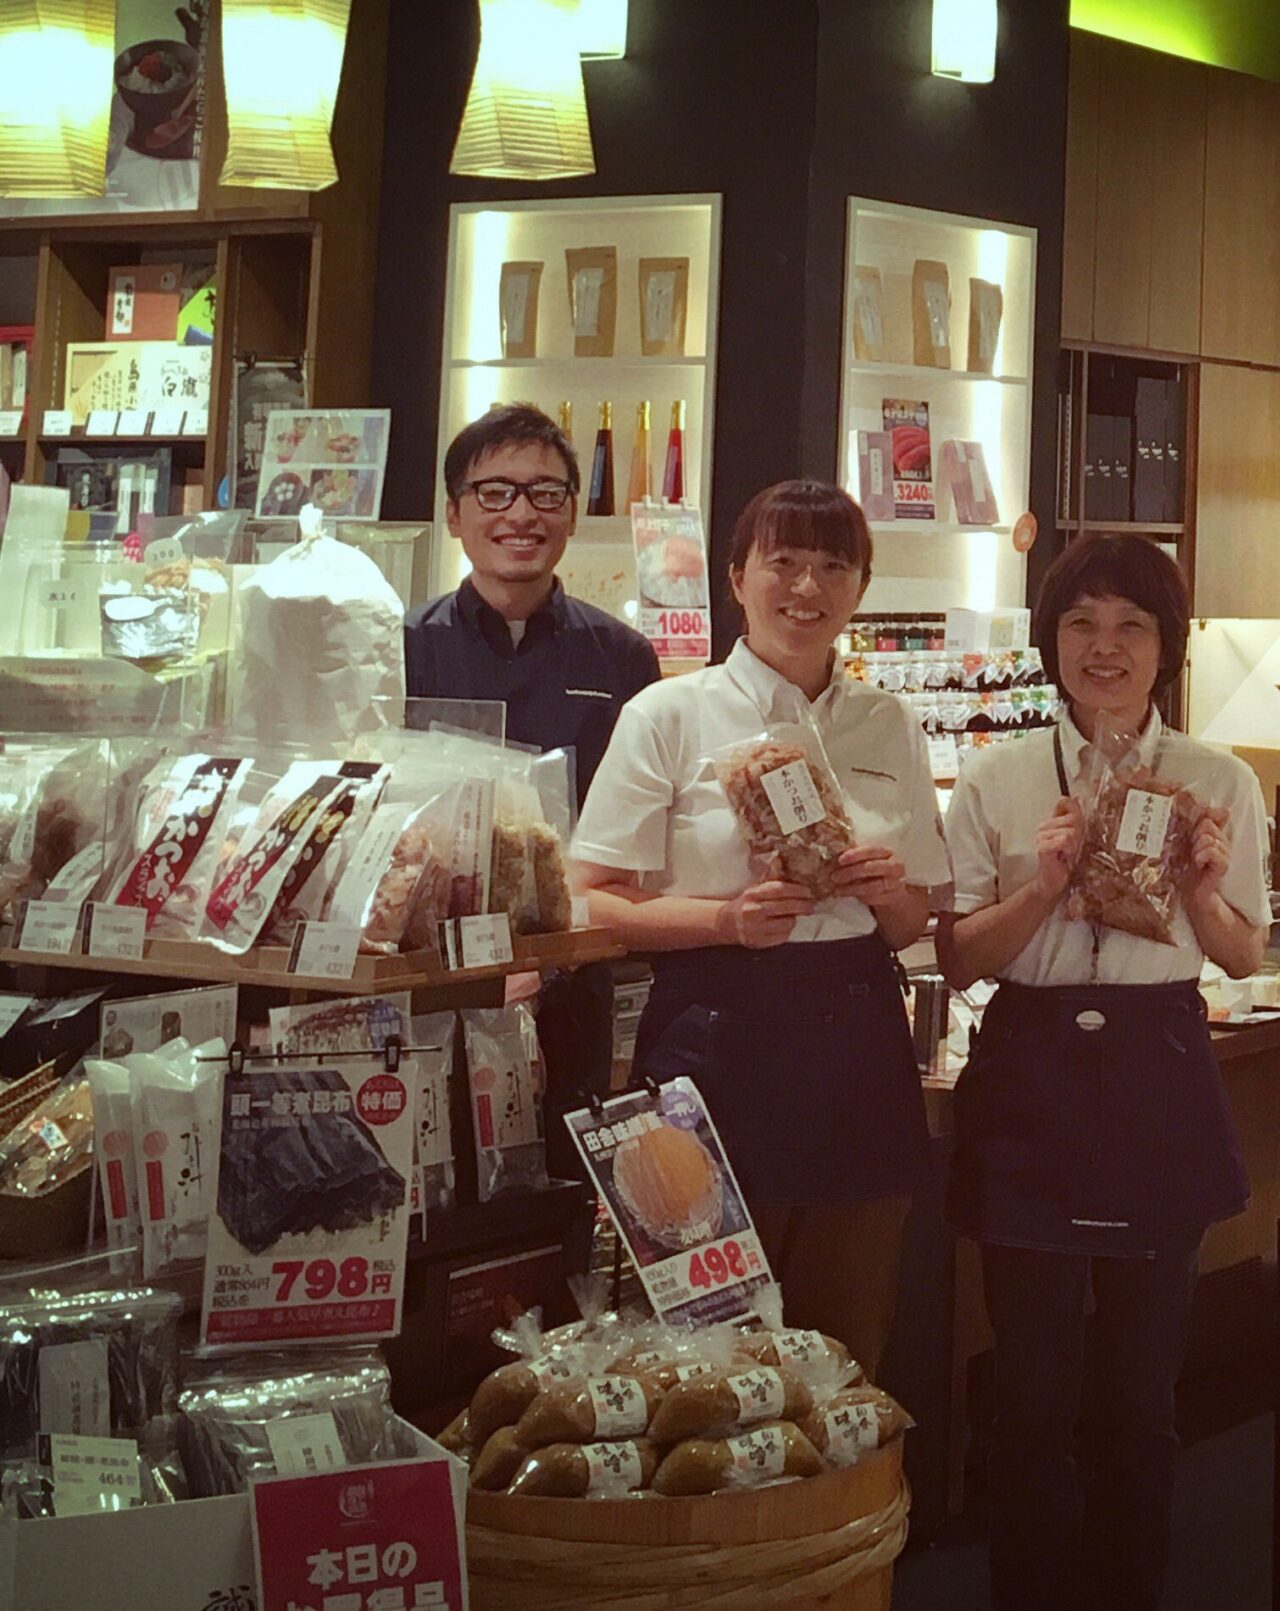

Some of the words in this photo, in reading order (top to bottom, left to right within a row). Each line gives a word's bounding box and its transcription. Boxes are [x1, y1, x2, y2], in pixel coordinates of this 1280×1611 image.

[659, 611, 704, 634] 1080
[272, 1256, 369, 1302] 798
[371, 1274, 393, 1295] 円
[689, 1240, 748, 1289] 498
[306, 1541, 418, 1591] 本日の
